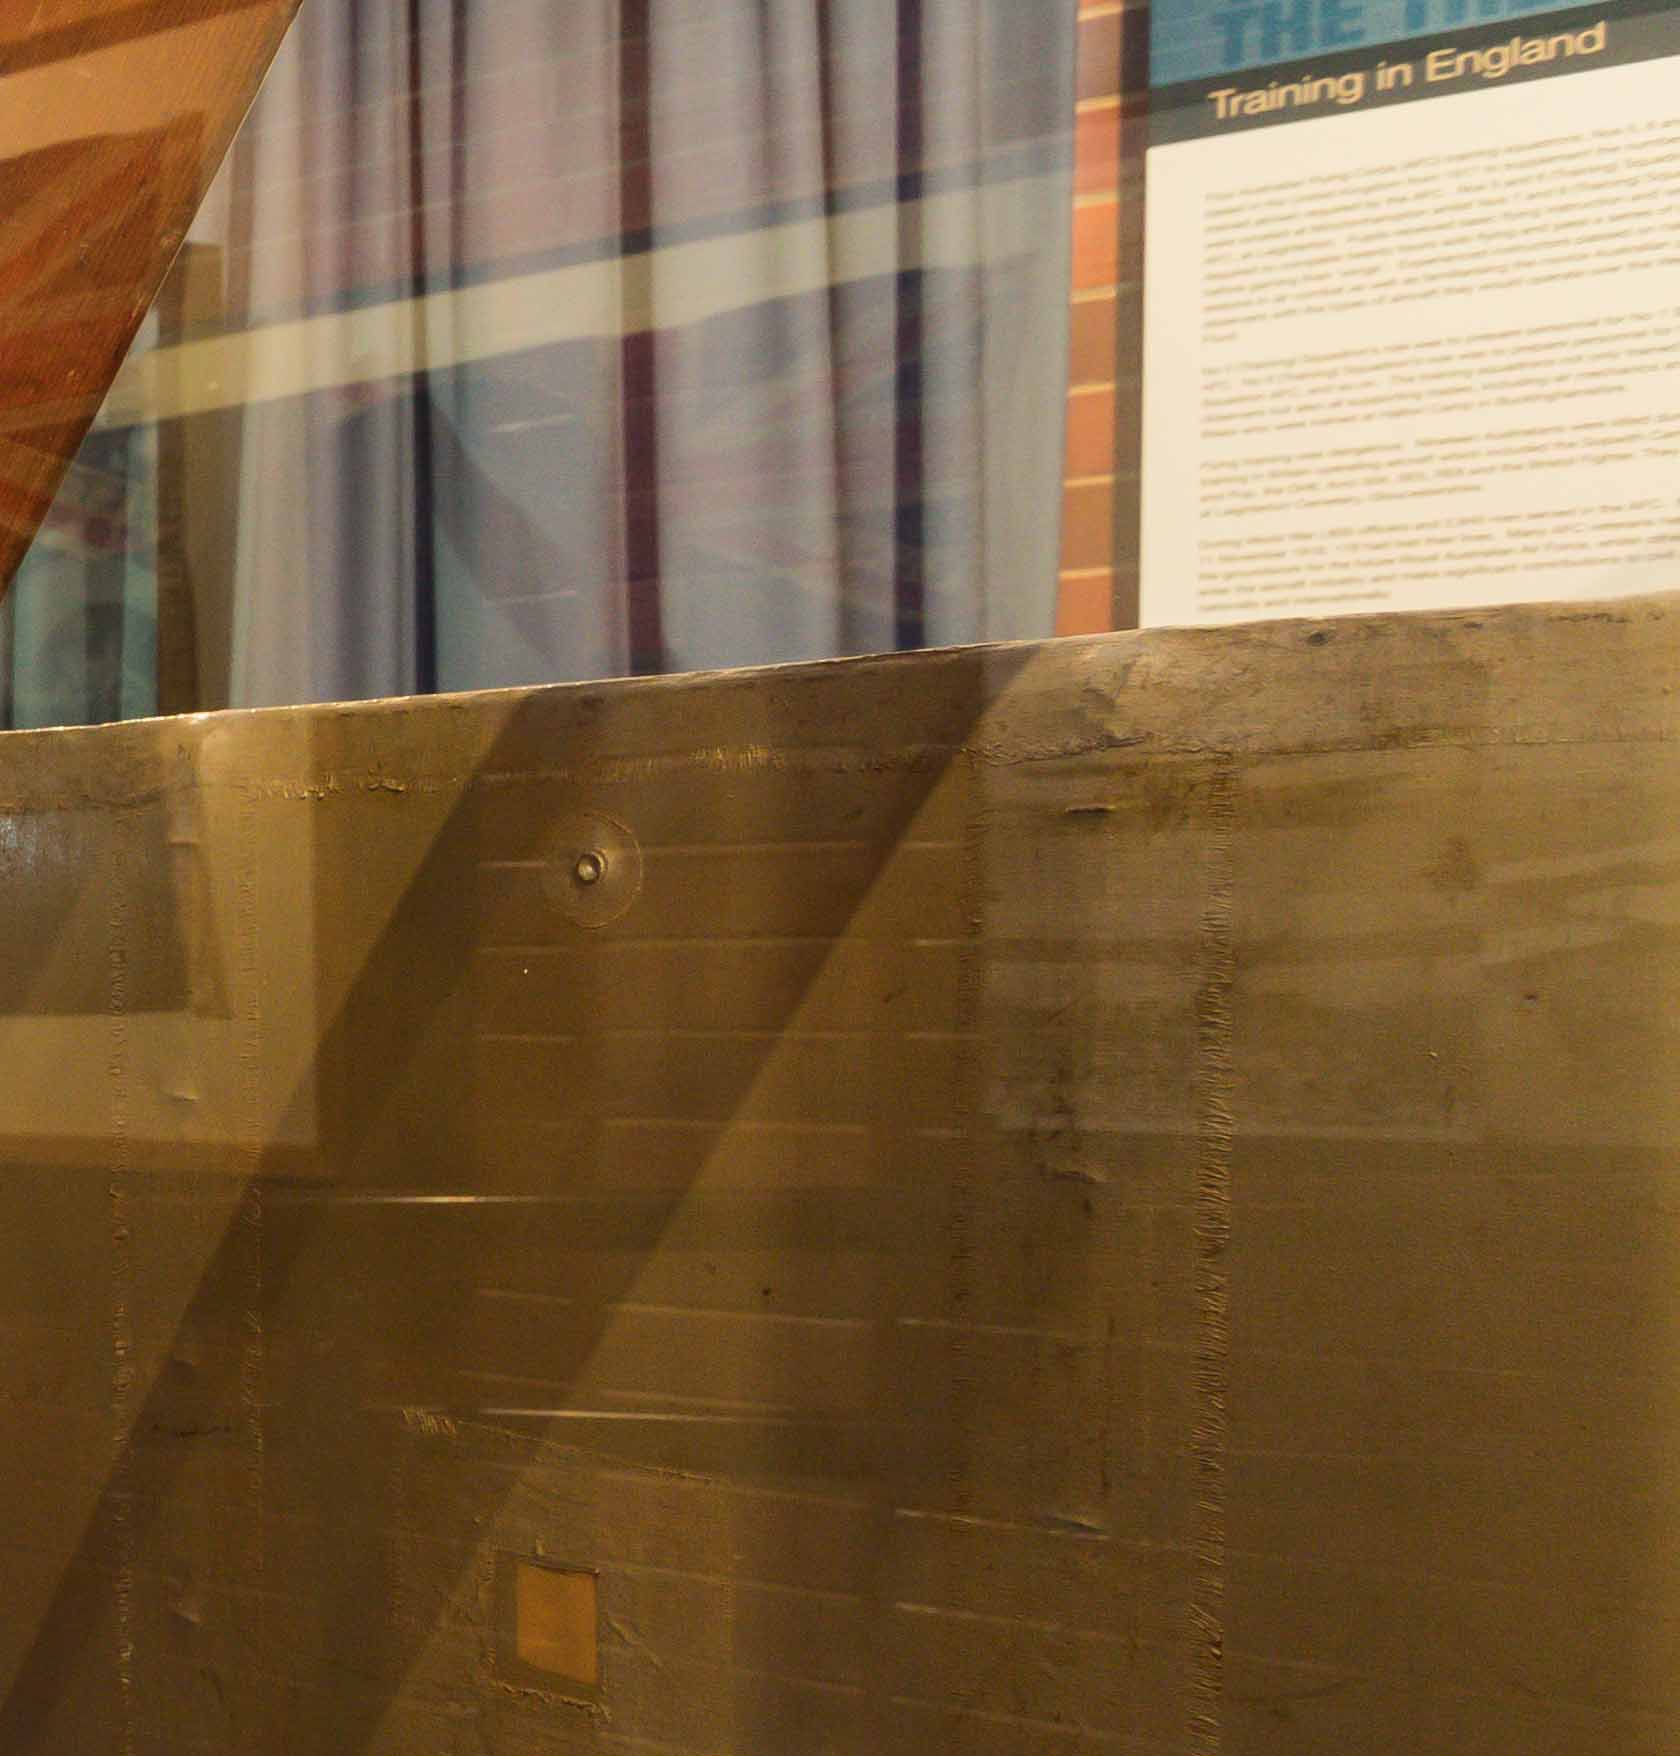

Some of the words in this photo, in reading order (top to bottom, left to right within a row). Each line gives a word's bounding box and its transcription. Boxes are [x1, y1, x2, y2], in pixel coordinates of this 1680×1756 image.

[1208, 73, 1365, 118] Training
[1376, 60, 1414, 91] in
[1427, 21, 1608, 80] England
